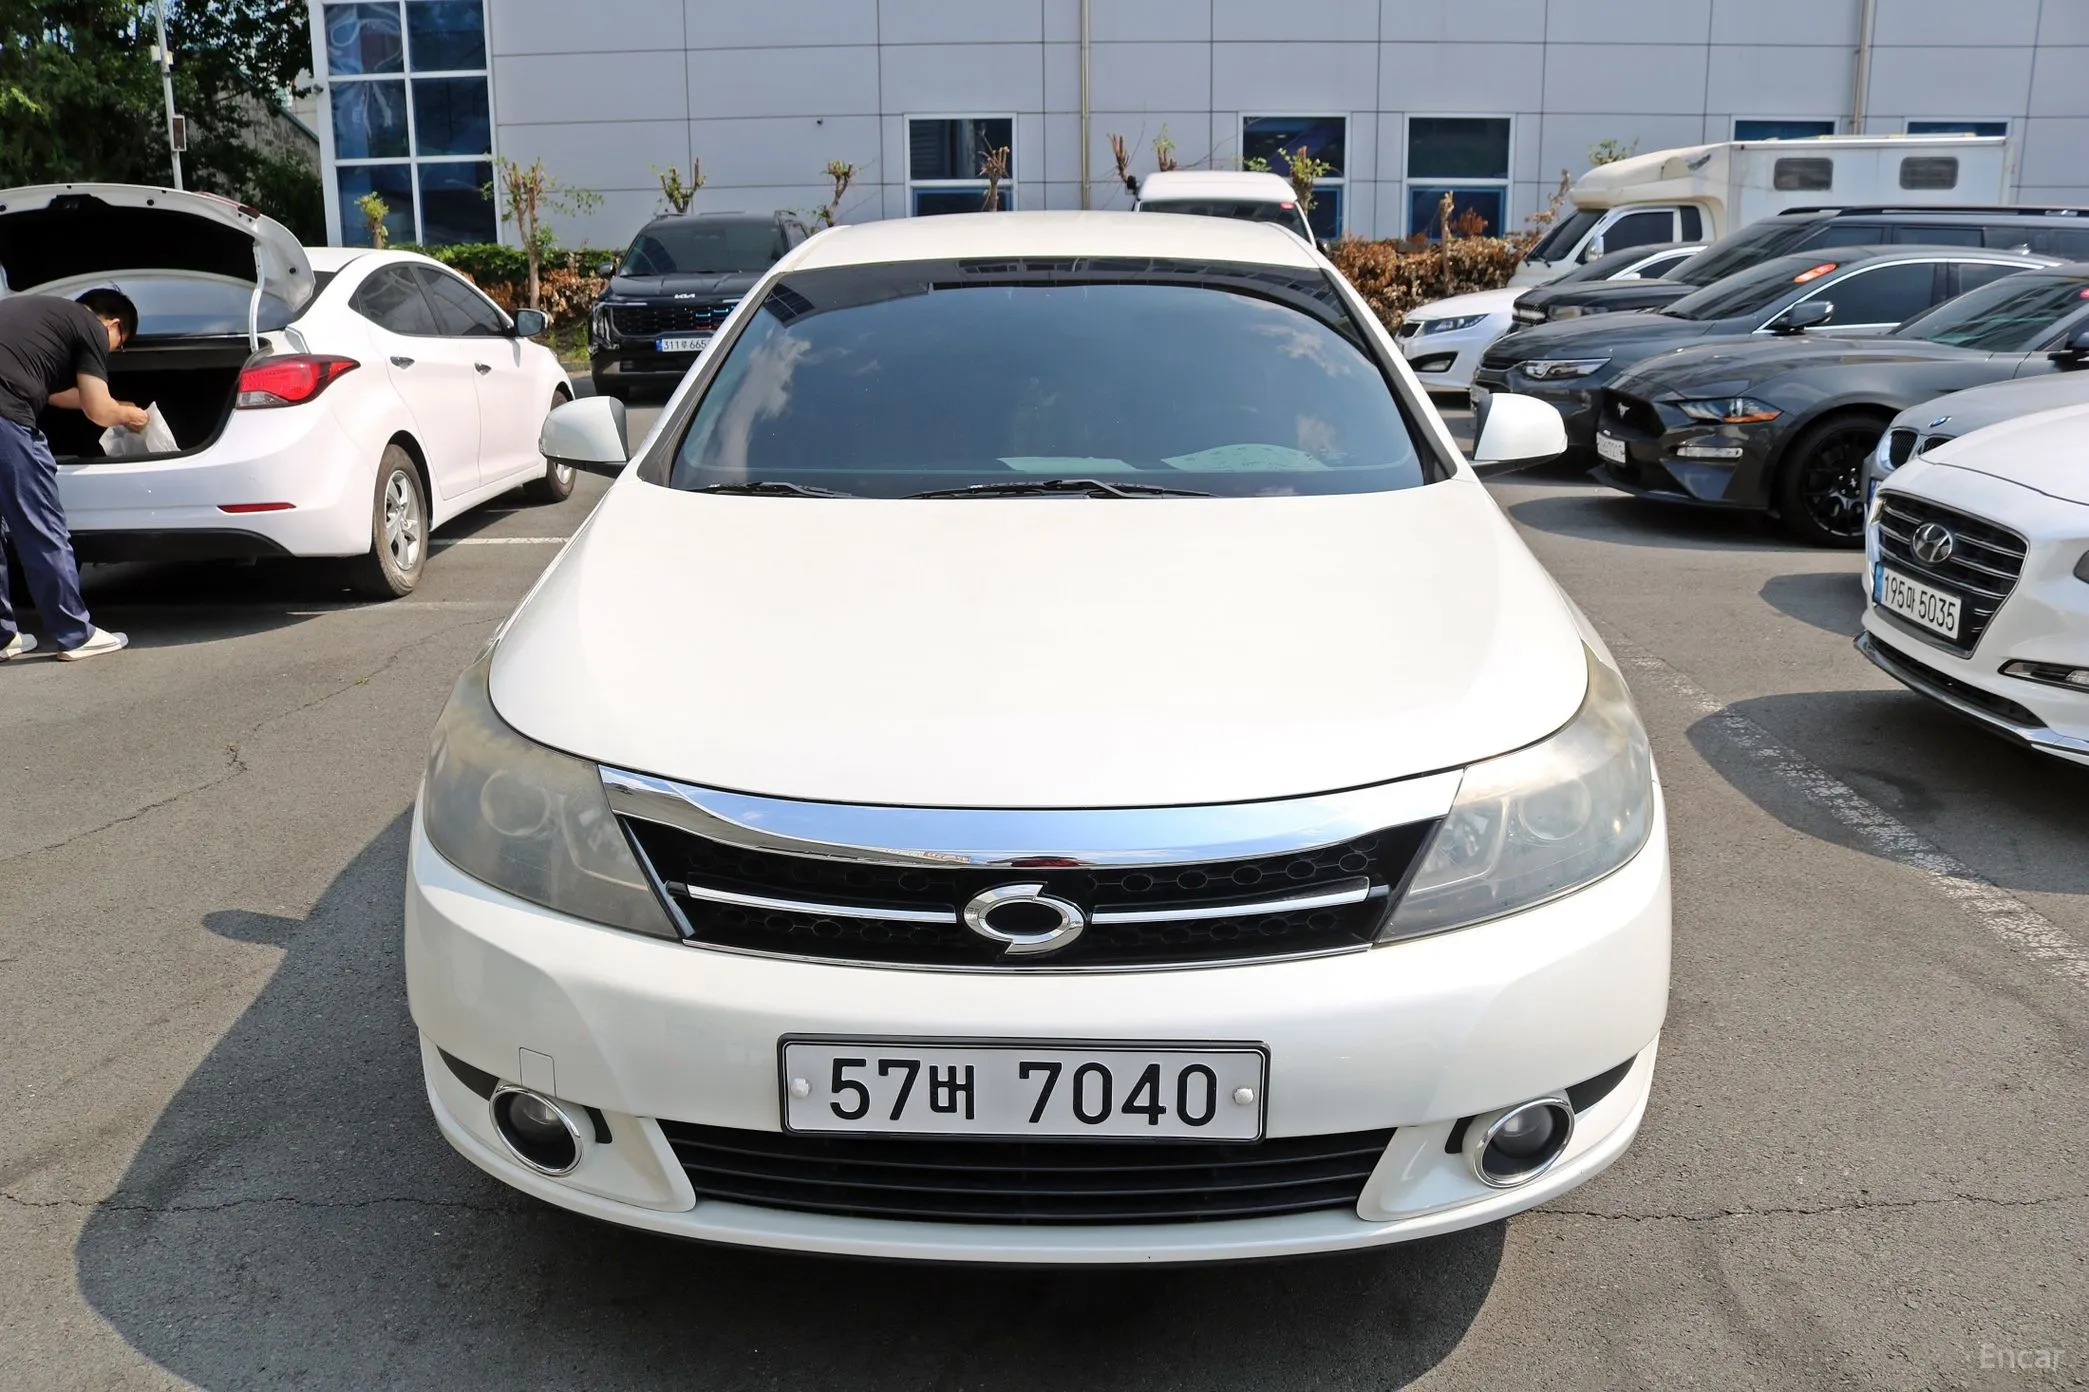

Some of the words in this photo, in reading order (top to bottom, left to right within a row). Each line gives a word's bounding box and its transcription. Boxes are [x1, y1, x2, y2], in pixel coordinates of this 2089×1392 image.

[1884, 575, 1916, 613] 195마
[1918, 589, 1956, 631] 5035
[829, 1057, 975, 1122] 57버
[1018, 1060, 1218, 1127] 7040
